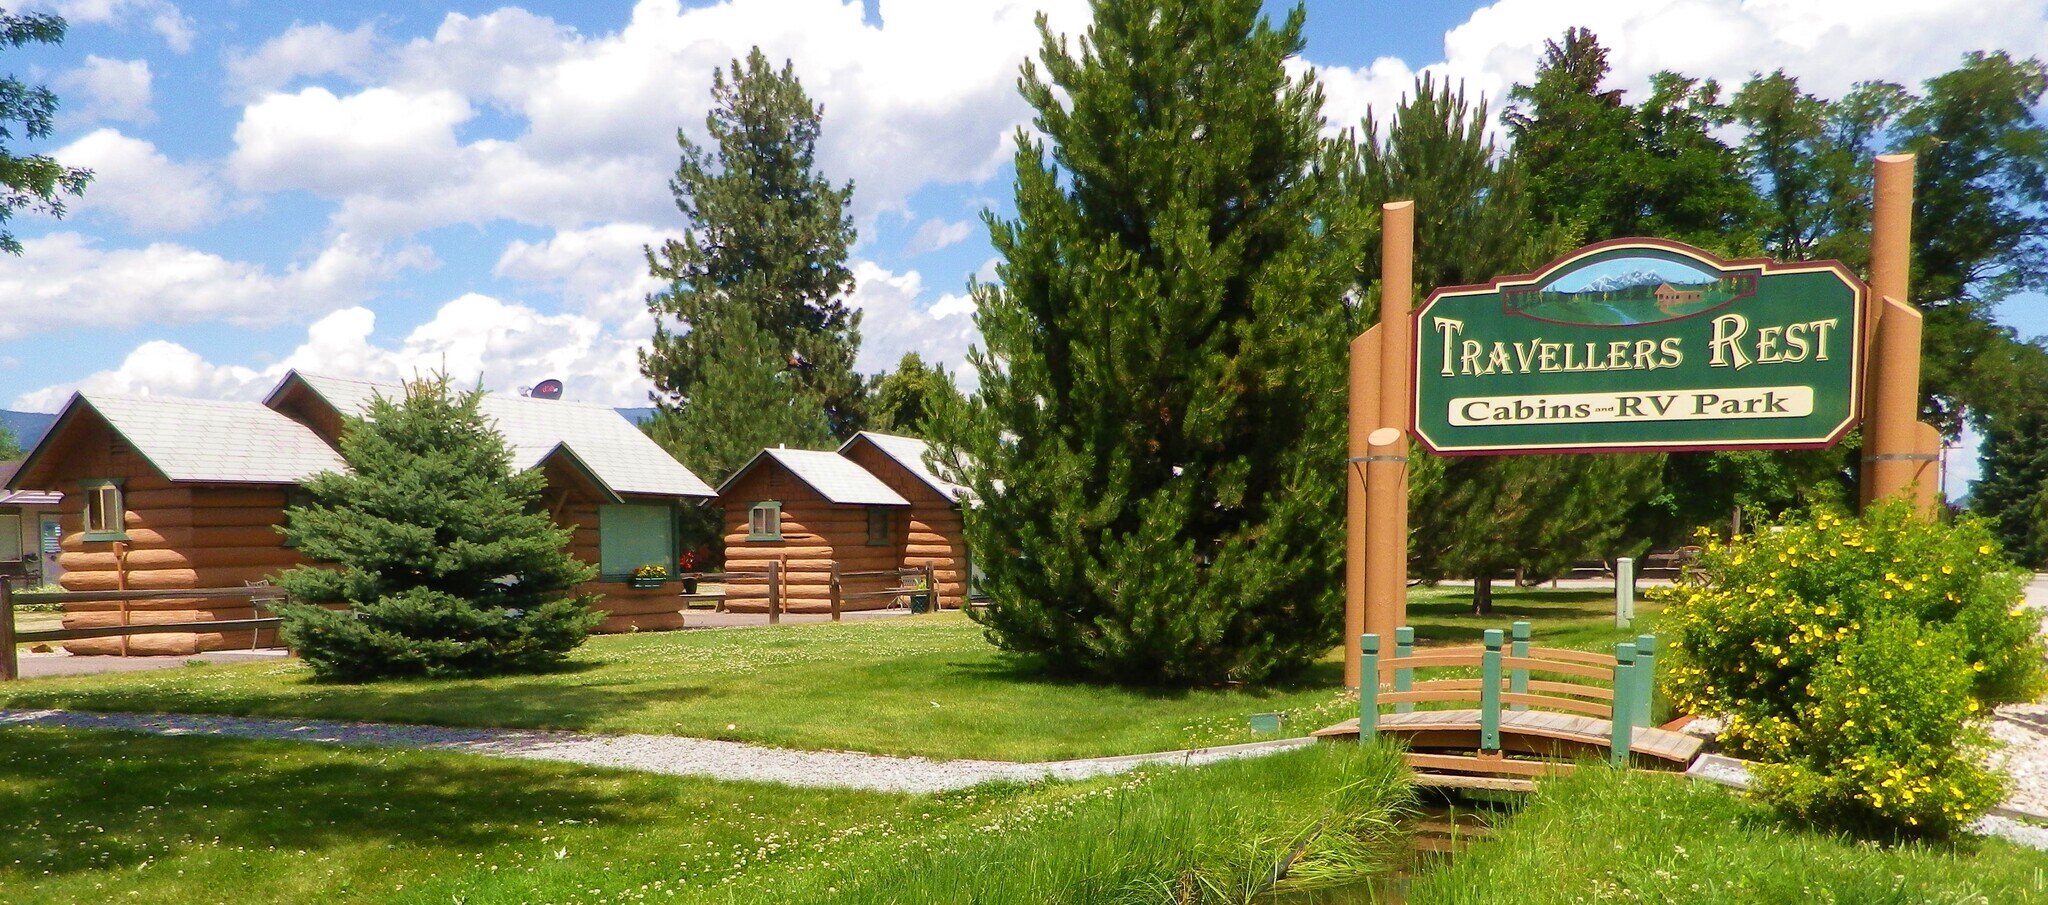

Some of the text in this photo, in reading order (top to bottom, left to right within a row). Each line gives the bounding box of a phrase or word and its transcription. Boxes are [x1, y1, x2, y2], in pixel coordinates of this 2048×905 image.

[1433, 313, 1838, 378] TRAVELLERS REST
[1461, 399, 1591, 422] Cabins
[1615, 395, 1679, 417] RV
[1690, 391, 1790, 416] Park
